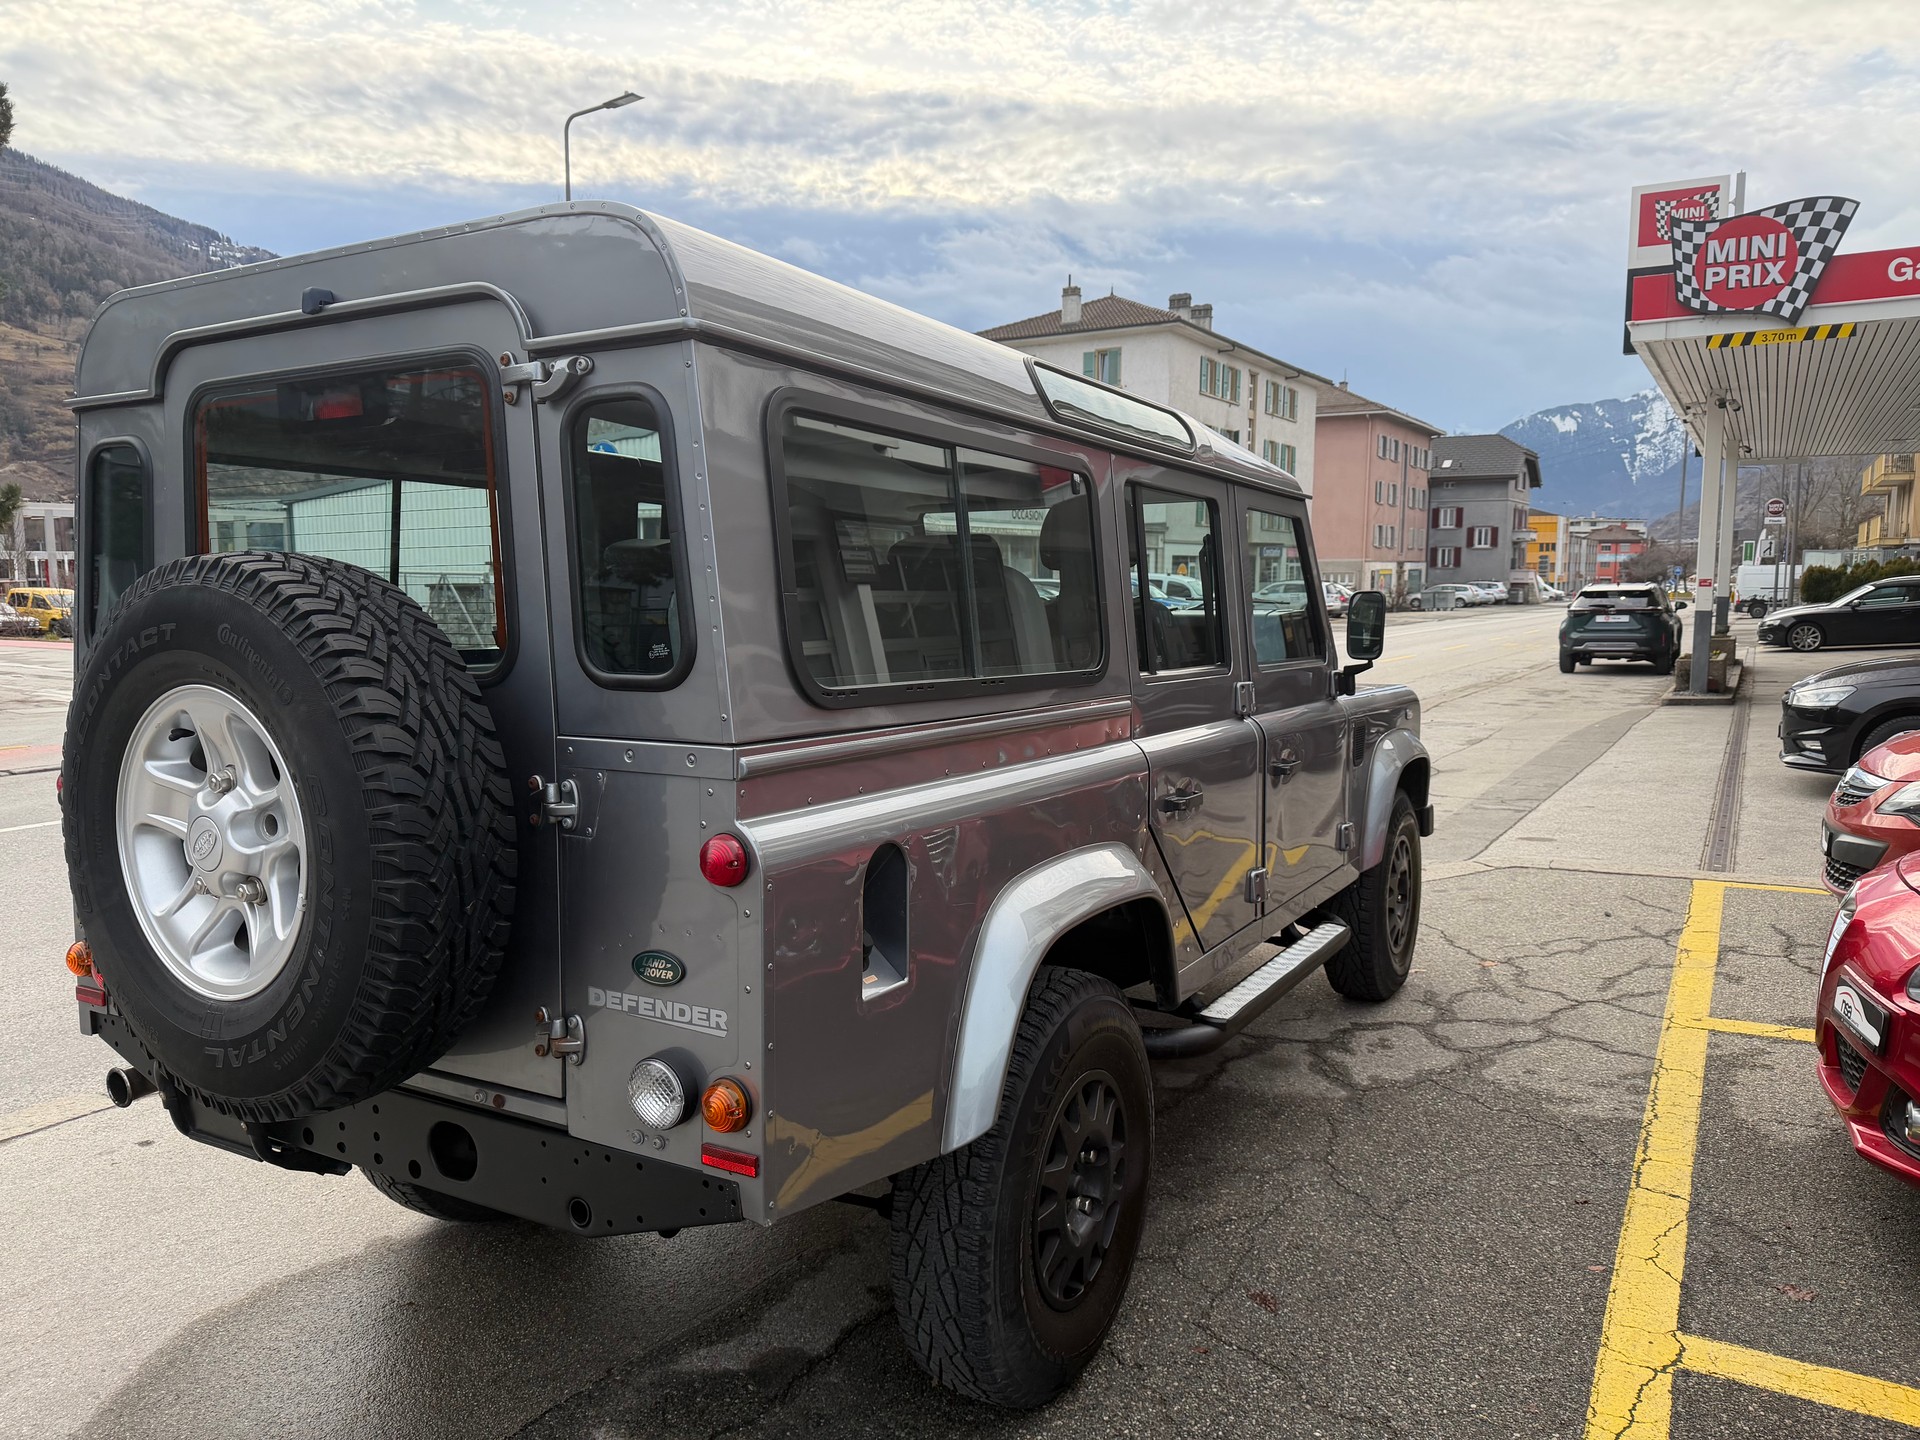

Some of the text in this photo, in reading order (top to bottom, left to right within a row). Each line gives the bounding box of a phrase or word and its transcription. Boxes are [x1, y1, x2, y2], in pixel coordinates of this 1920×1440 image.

[1671, 206, 1705, 219] MINI
[1706, 232, 1788, 265] MINI
[1704, 260, 1787, 291] PRIX
[1761, 332, 1785, 343] 3.70
[77, 623, 177, 745] CONTACT
[204, 774, 335, 1068] CONTINENTAL
[642, 957, 667, 969] LAND
[644, 968, 674, 980] ROVER
[588, 986, 728, 1031] DEFENDER
